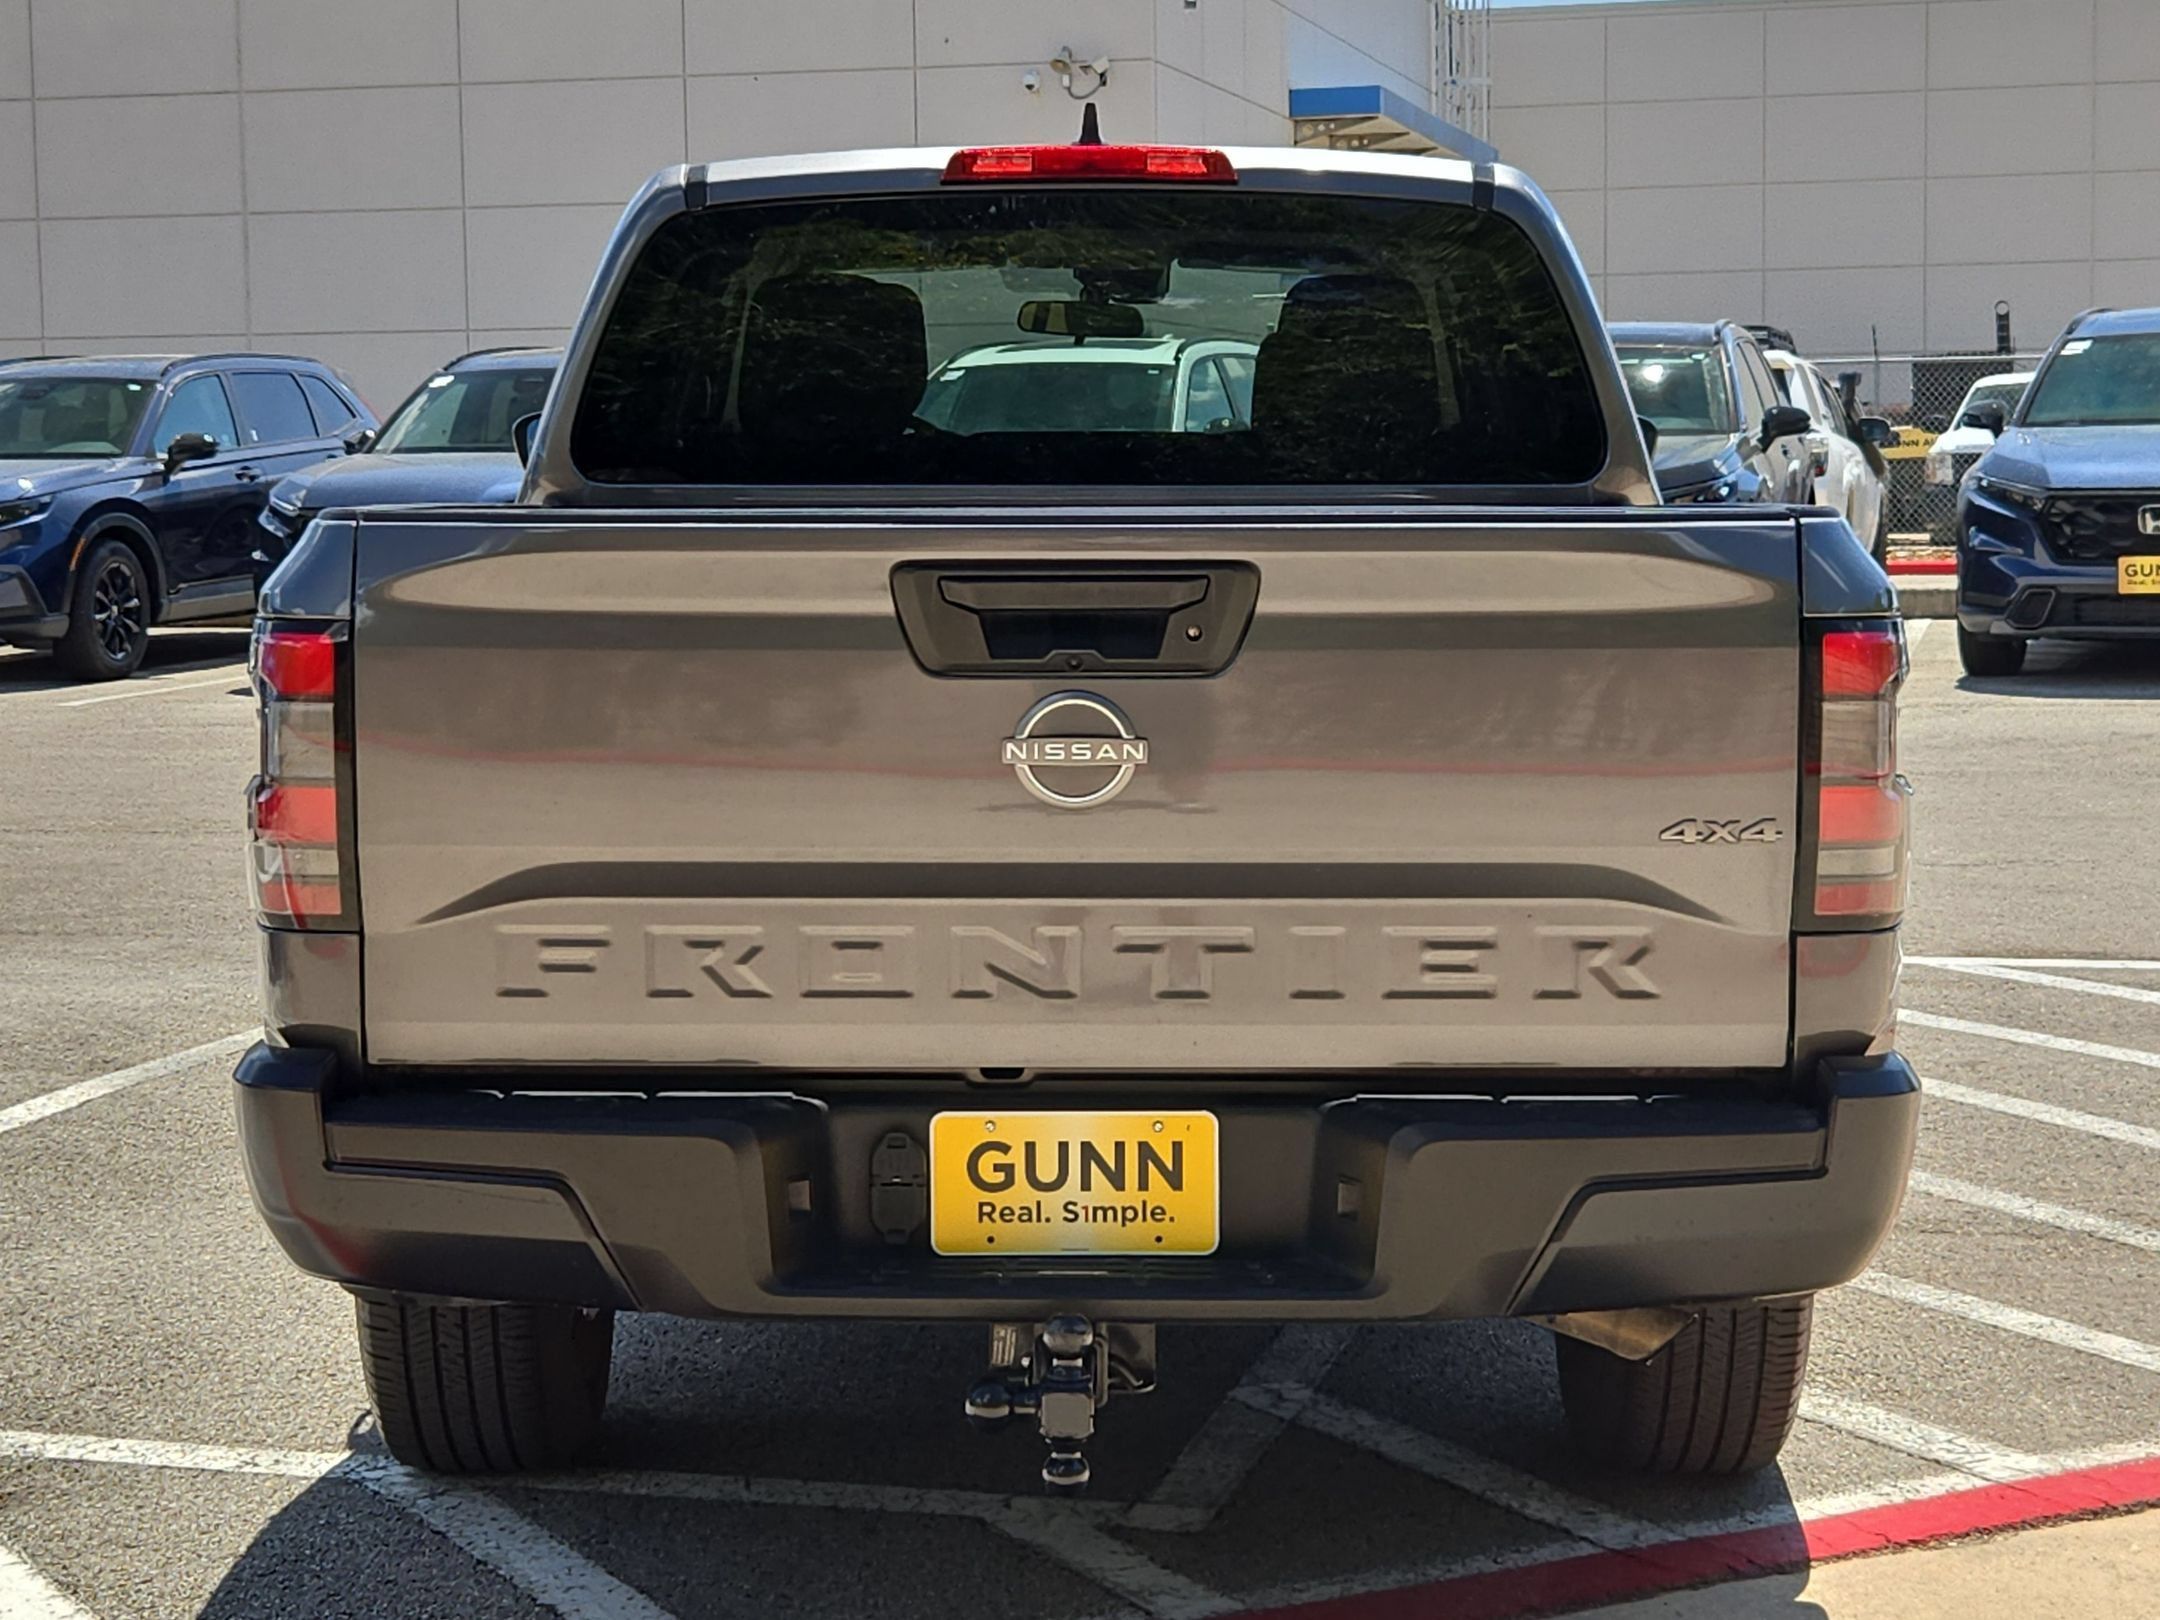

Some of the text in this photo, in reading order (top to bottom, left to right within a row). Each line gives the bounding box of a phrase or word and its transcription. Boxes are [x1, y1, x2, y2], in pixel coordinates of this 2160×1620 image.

[1005, 743, 1144, 760] NISSAN
[495, 923, 1663, 999] FRONTIER
[966, 1141, 1183, 1193] GUNN
[978, 1200, 1051, 1223] Real.
